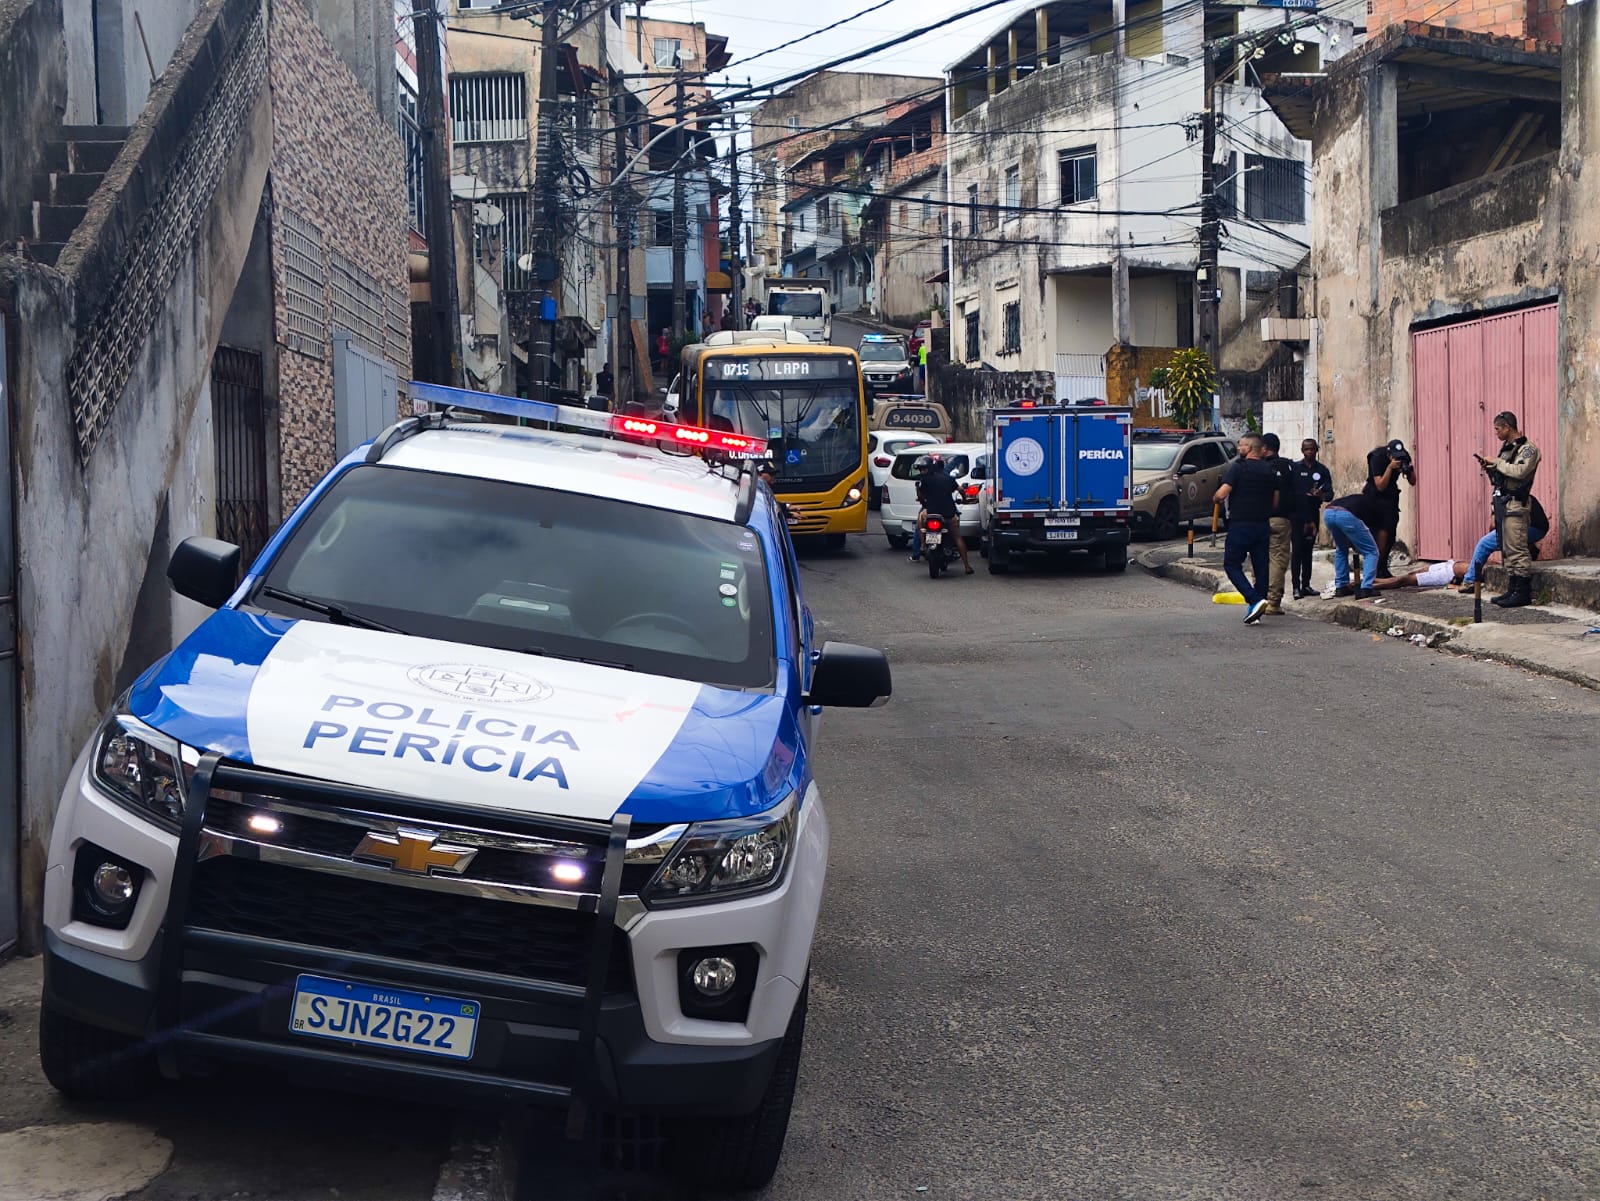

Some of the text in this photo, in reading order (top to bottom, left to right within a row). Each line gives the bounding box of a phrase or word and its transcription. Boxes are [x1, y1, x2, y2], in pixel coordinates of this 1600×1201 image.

[723, 362, 809, 376] 0715 LAPA
[892, 413, 932, 424] 9.4030
[1078, 447, 1124, 460] PERÍCIA
[320, 694, 581, 752] POLÍCIA
[302, 720, 570, 790] PERÍCIA
[372, 993, 402, 1006] BRASIL
[293, 1018, 305, 1030] BR
[307, 996, 456, 1049] SJN2G22
